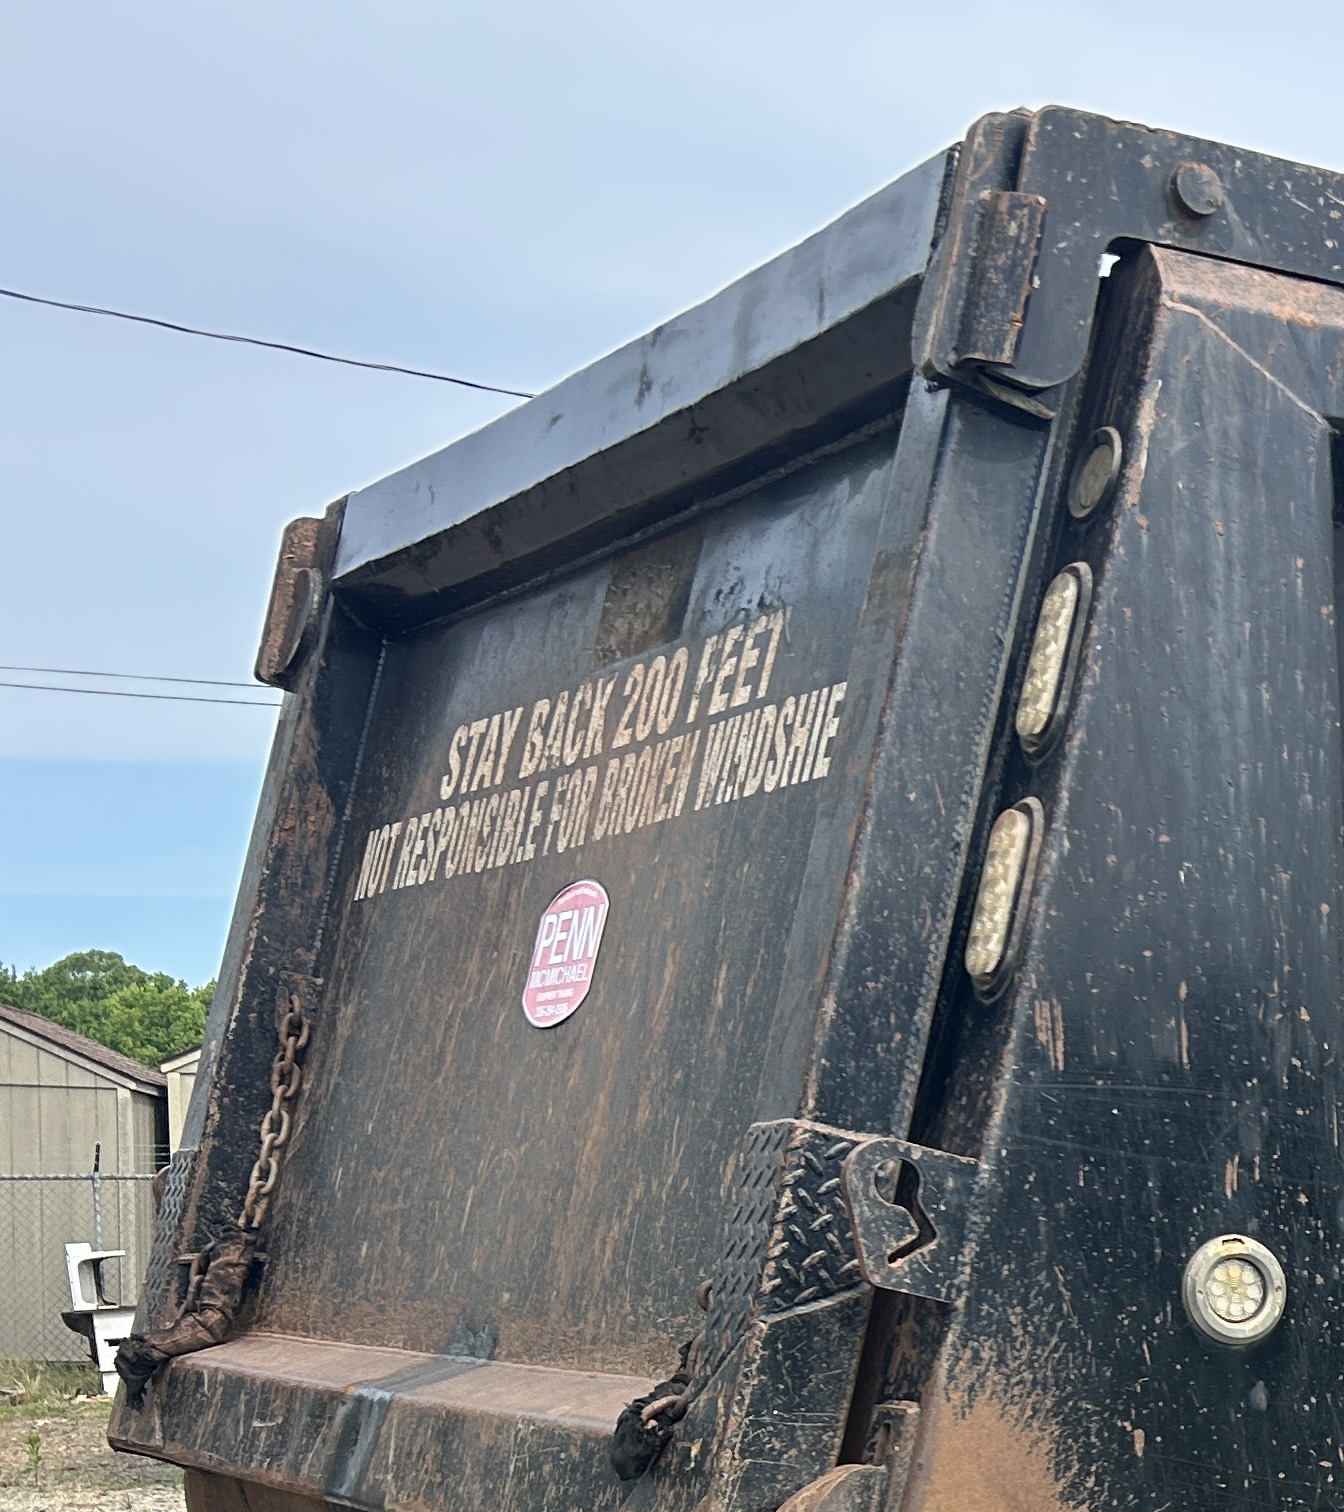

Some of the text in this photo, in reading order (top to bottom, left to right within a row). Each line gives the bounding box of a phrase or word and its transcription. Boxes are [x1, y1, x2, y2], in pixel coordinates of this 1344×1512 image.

[354, 682, 847, 901] NOT RESPONSIBLE FOR BROKEN WINDSHIE
[440, 608, 785, 800] STAY BACK 200 FEET
[533, 903, 605, 968] PENN
